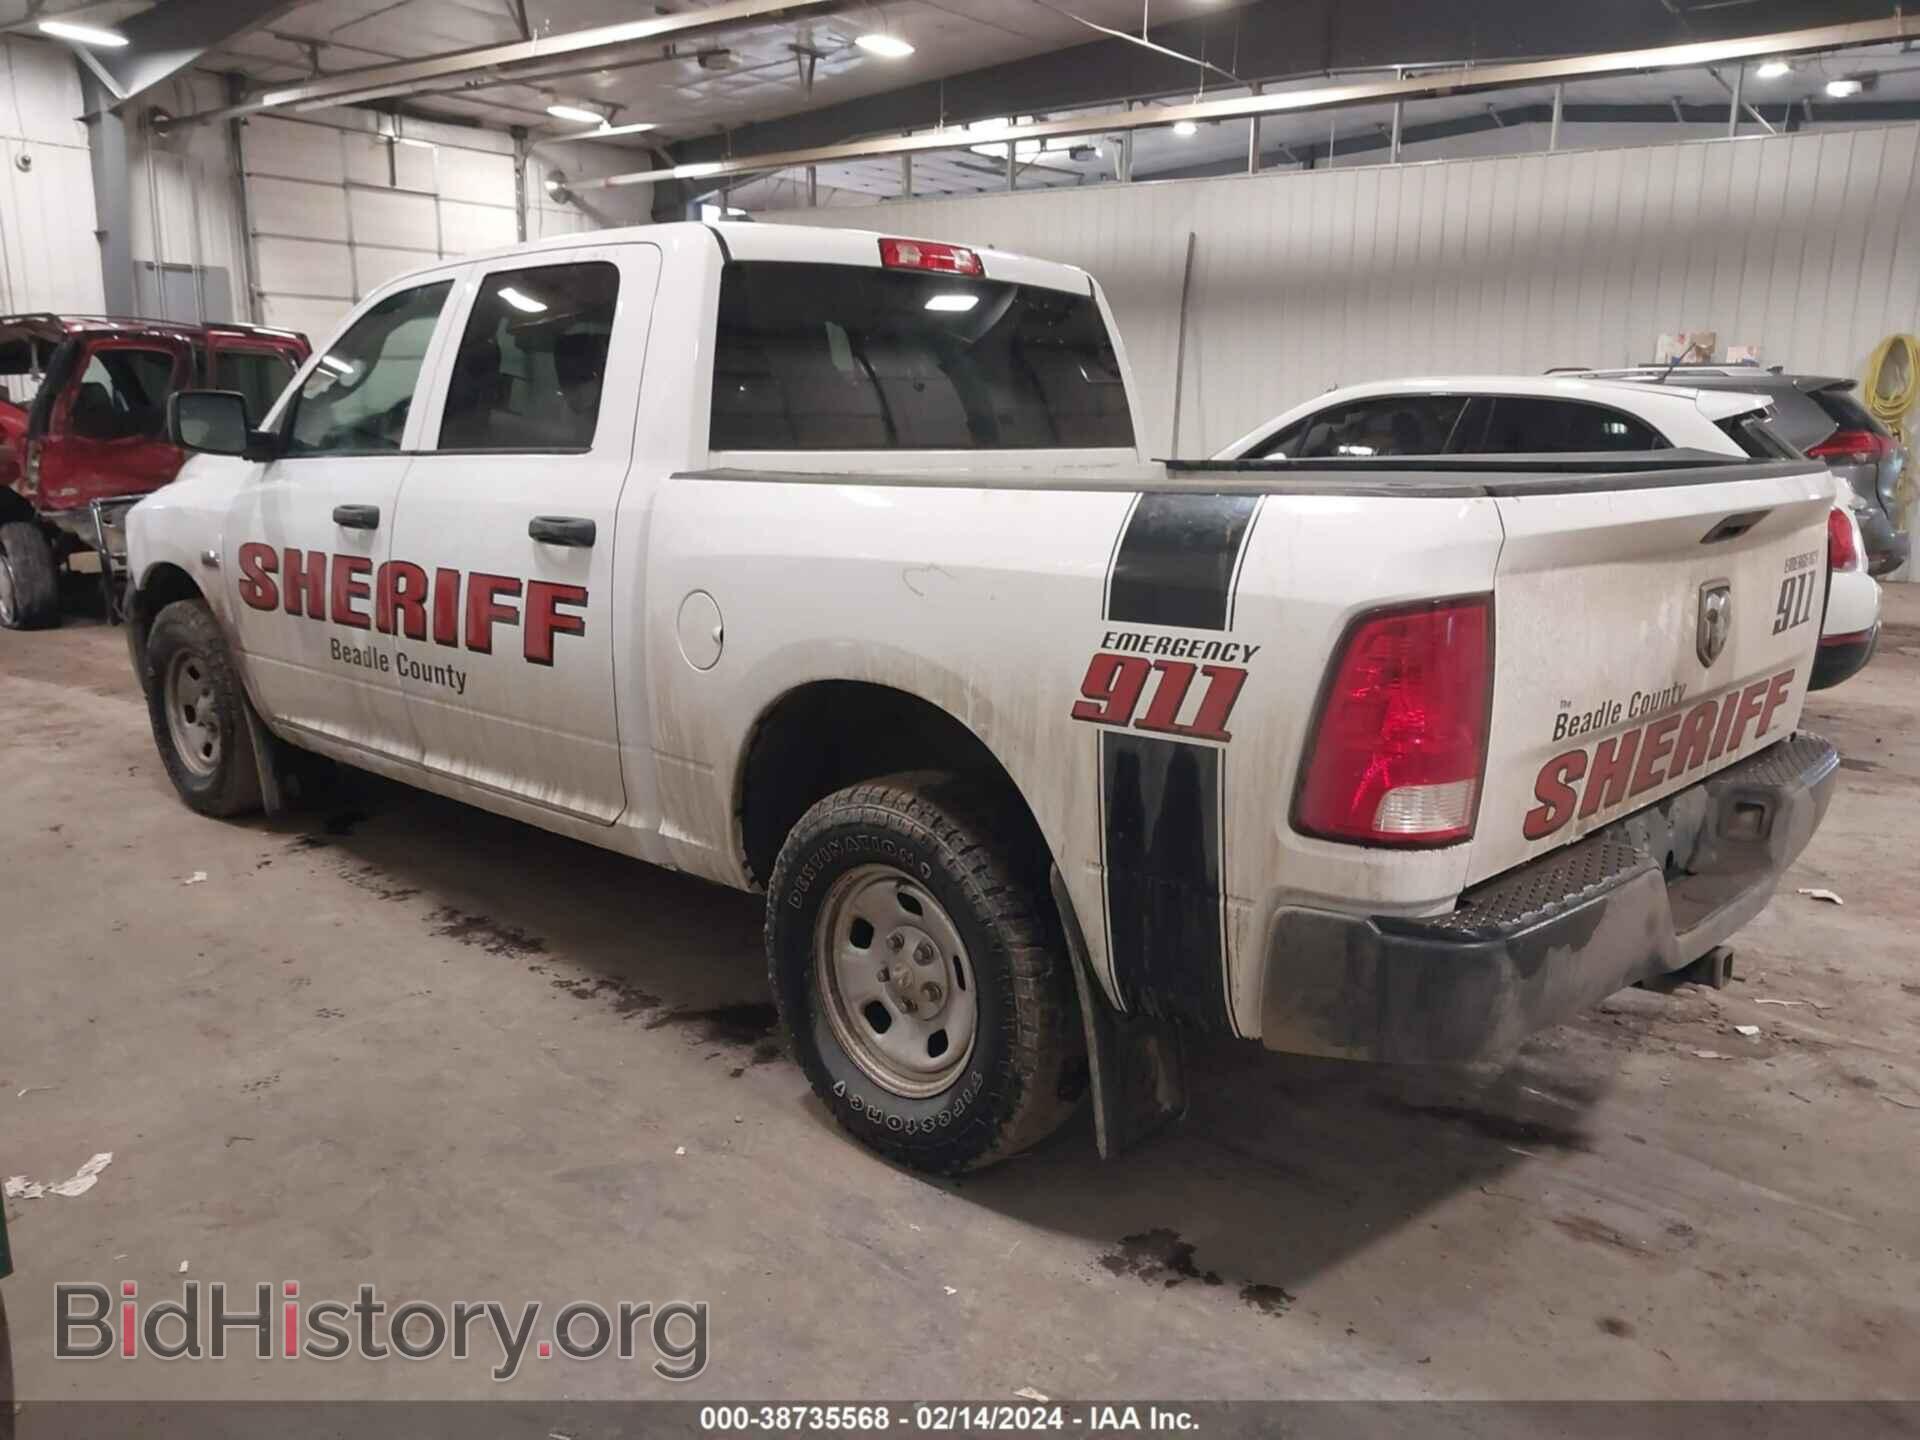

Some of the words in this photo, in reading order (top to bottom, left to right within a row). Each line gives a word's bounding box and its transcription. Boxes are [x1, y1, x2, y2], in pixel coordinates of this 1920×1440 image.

[238, 542, 589, 667] SHERIFF
[1772, 569, 1816, 636] 911
[330, 638, 389, 673] Beadle
[397, 652, 467, 695] County
[1101, 631, 1261, 664] EMERGENCY
[1070, 652, 1248, 743] 911
[1552, 699, 1622, 742] Beadle
[1628, 681, 1687, 719] County
[1523, 668, 1796, 841] SHERIFF
